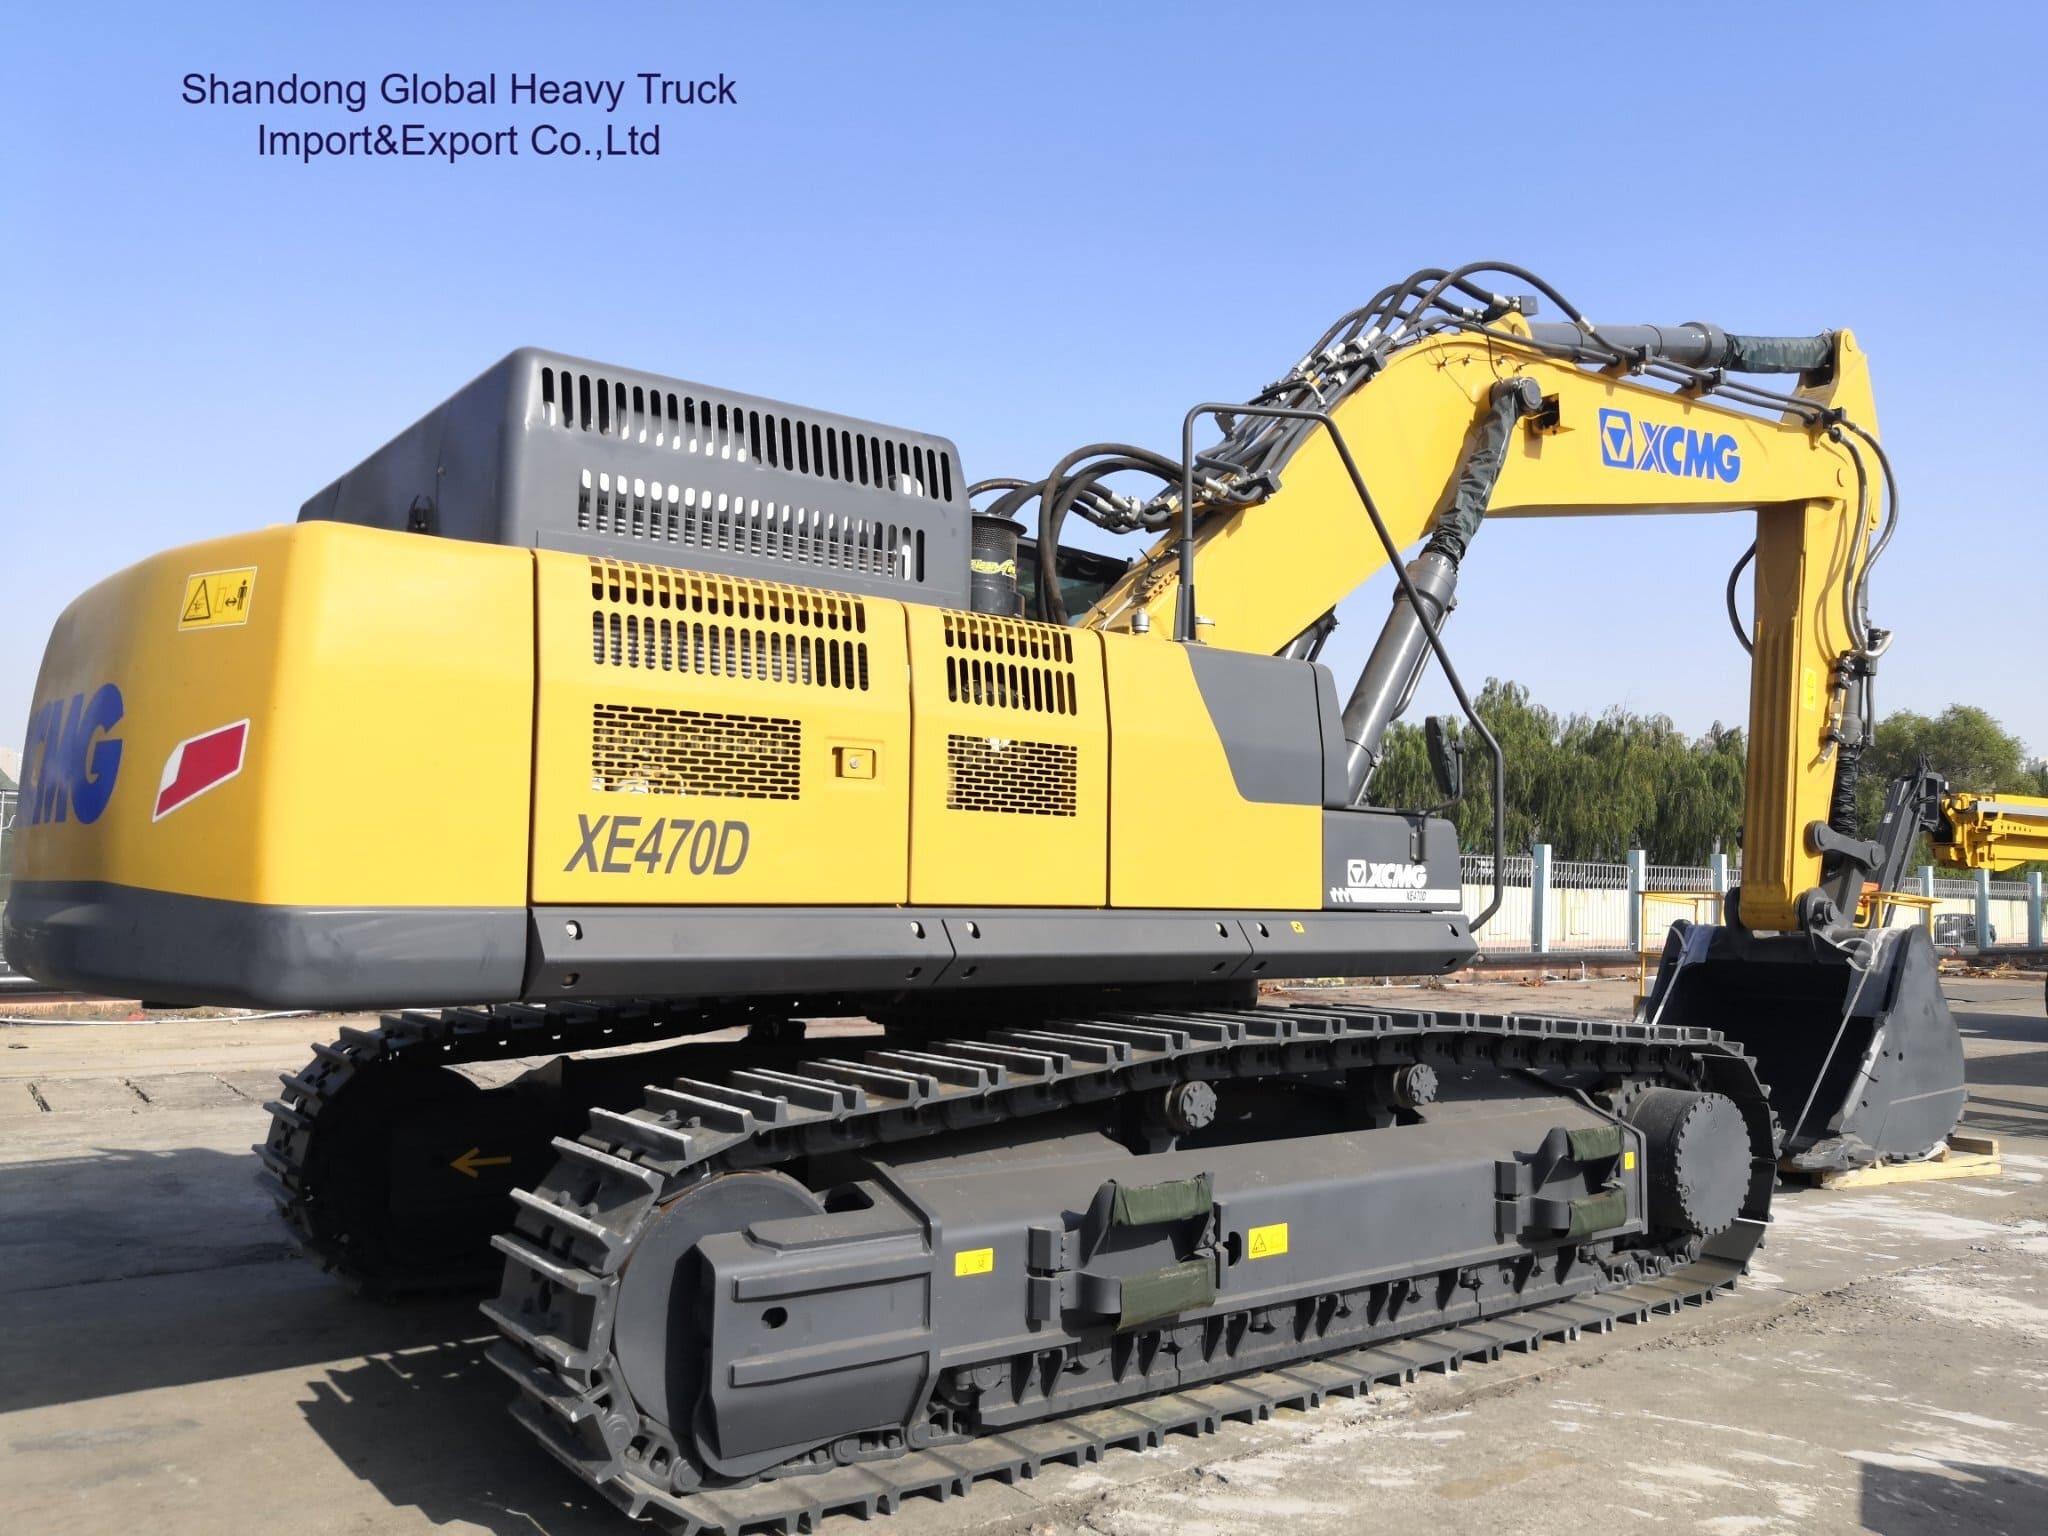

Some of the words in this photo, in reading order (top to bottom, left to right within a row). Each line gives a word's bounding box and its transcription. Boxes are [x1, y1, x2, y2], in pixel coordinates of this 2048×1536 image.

[1636, 421, 1741, 483] XCMG
[563, 814, 750, 875] XE470D
[1367, 863, 1427, 889] XCMG
